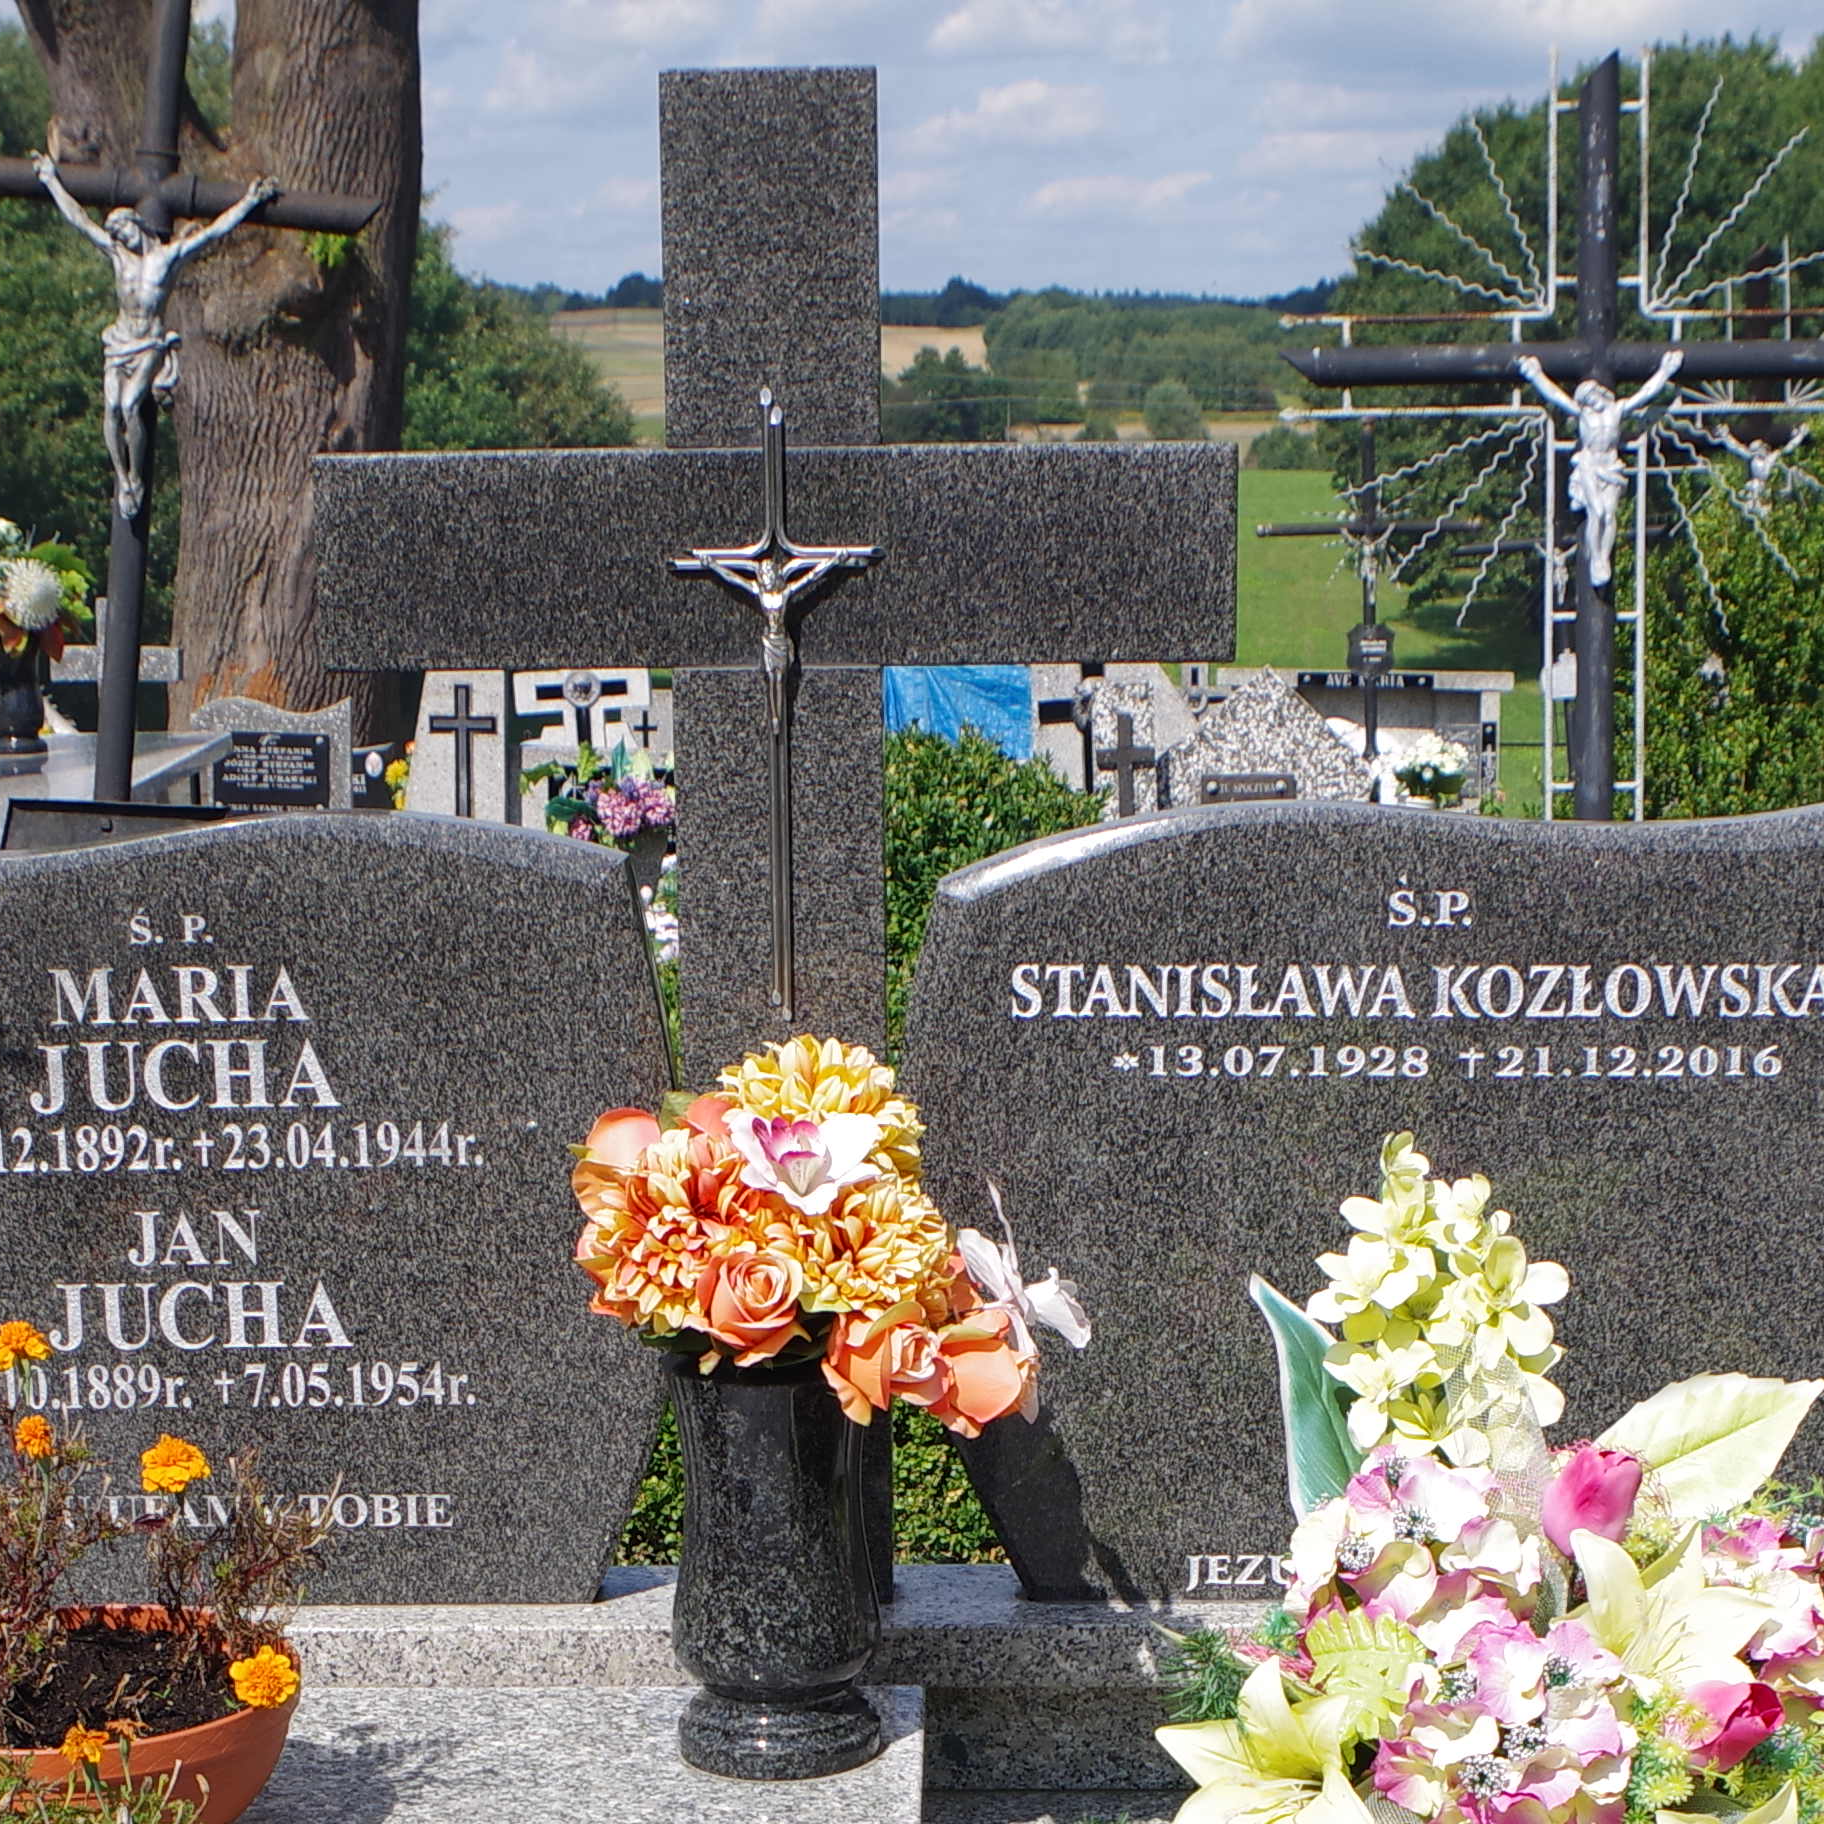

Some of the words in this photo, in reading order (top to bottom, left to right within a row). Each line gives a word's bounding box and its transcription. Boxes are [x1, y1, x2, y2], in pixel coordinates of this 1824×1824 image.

[1325, 672, 1353, 688] AVE
[46, 964, 311, 1027] MARIA
[1009, 961, 1417, 1021] STANISŁAWA
[28, 1037, 342, 1116] JUCHA
[1149, 1044, 1431, 1079] 13.07.1928
[1494, 1044, 1783, 1079] 21.12.2016
[221, 1119, 485, 1171] 23.04.1944r.
[126, 1208, 262, 1269] JAN
[47, 1279, 355, 1353] JUCHA
[242, 1360, 478, 1409] 7.05.1954r.
[297, 1492, 455, 1529] TOBIE
